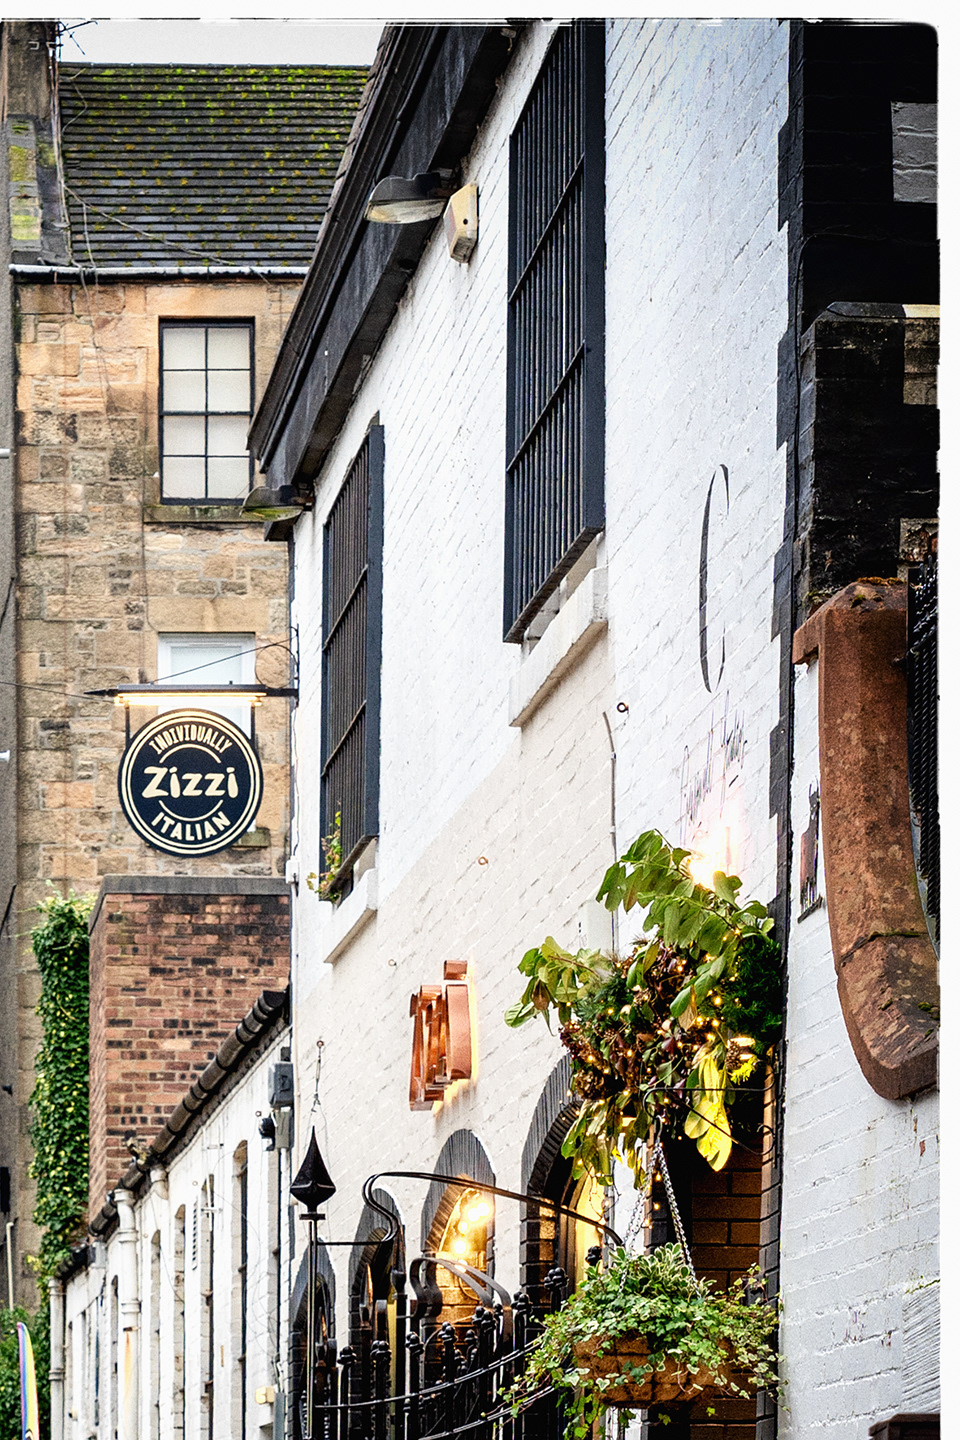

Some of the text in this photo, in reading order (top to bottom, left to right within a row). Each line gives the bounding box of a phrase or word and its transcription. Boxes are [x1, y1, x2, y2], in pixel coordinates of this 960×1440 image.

[148, 724, 234, 755] INDIVIDUALLY
[141, 765, 239, 799] Zizzi
[151, 810, 232, 842] ITALIAN
